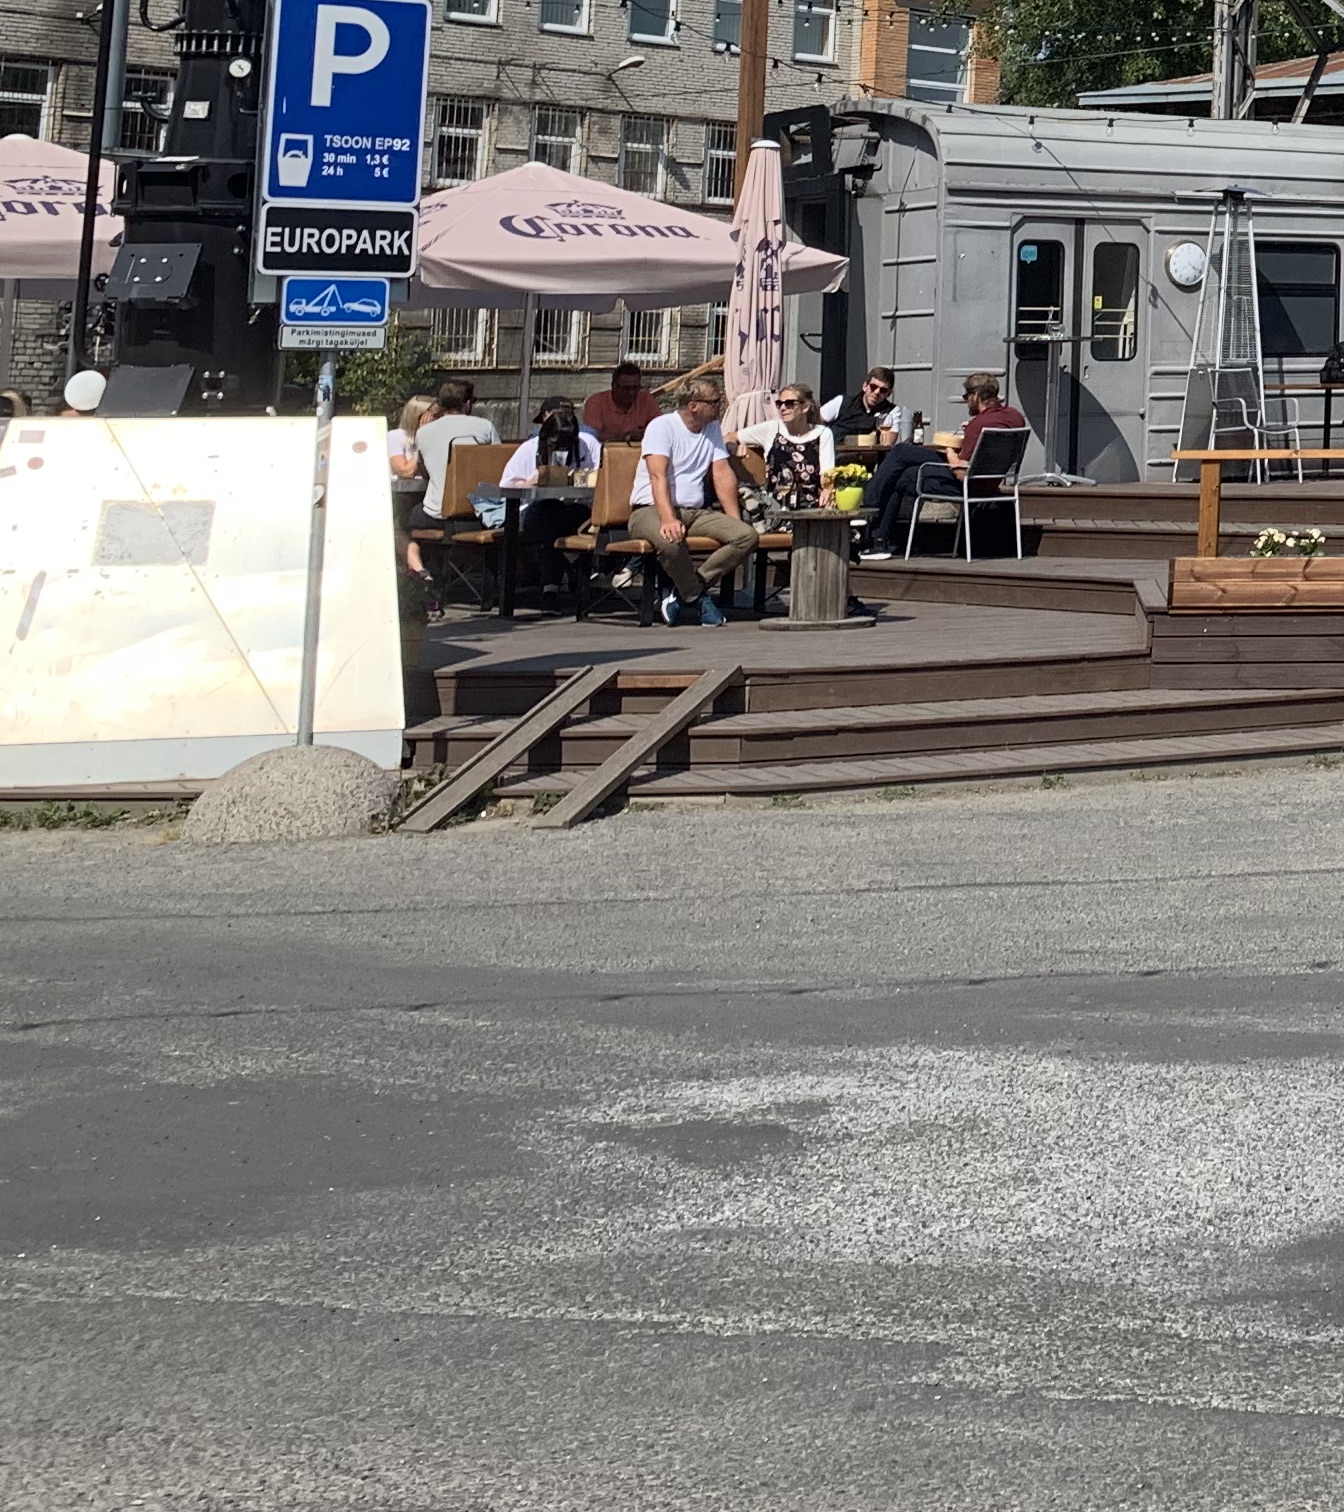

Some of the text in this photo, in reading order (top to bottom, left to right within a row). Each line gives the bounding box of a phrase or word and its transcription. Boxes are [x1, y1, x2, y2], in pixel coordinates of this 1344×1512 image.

[310, 4, 390, 107] P
[324, 134, 410, 151] TSOON EP92
[323, 153, 335, 163] 30
[337, 153, 356, 164] min
[366, 154, 380, 165] 1,3
[322, 165, 334, 176] 24
[336, 166, 343, 176] h
[374, 168, 381, 177] 5
[499, 214, 700, 242] Corona
[265, 227, 411, 256] EUROPARK
